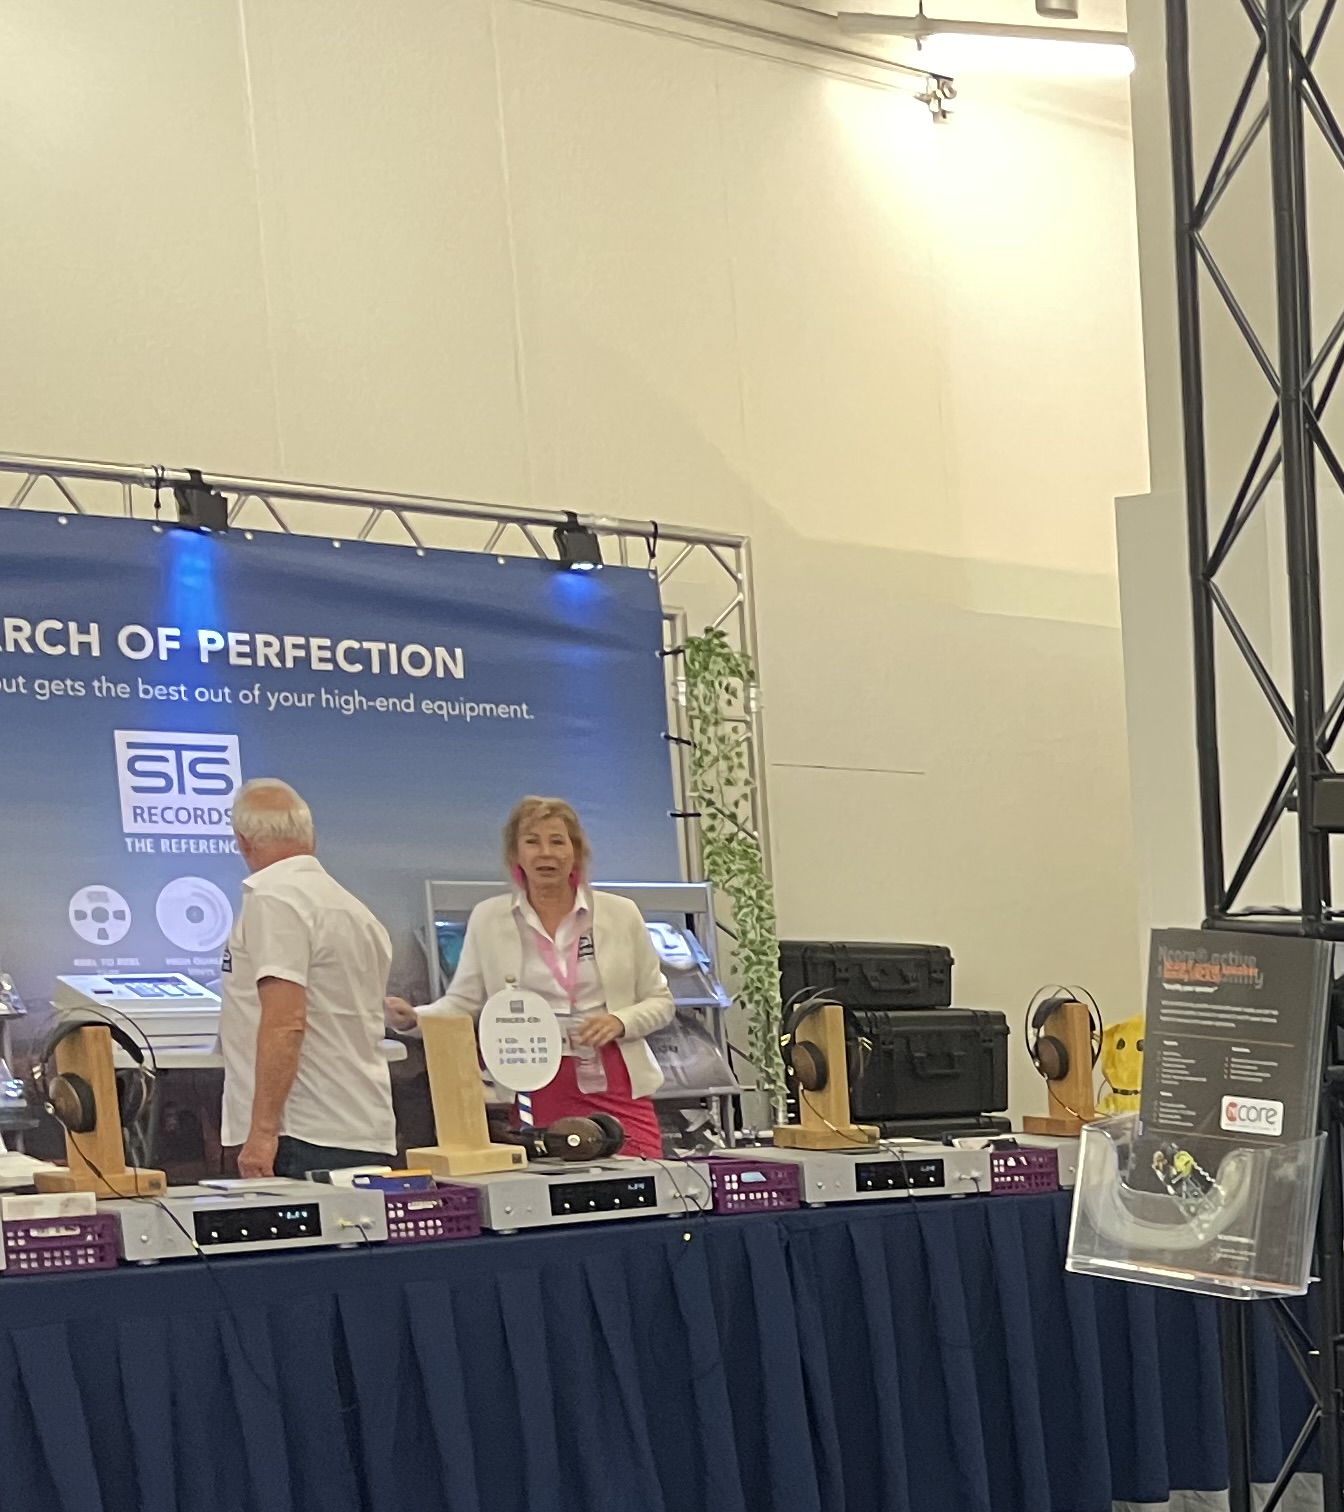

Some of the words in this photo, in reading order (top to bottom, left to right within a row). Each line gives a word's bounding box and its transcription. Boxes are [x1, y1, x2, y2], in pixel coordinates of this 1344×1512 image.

[0, 617, 99, 657] RCH
[118, 624, 181, 660] OF
[197, 629, 464, 679] PERFECTION
[0, 676, 27, 694] ut
[34, 678, 85, 700] gets
[92, 675, 130, 698] the
[138, 677, 188, 701] best
[195, 684, 232, 703] out
[238, 683, 261, 704] of
[267, 690, 315, 711] your
[321, 687, 414, 715] high-end
[421, 696, 534, 722] equipment.
[126, 741, 234, 796] STS
[132, 805, 232, 826] RECORDS
[124, 837, 154, 853] THE
